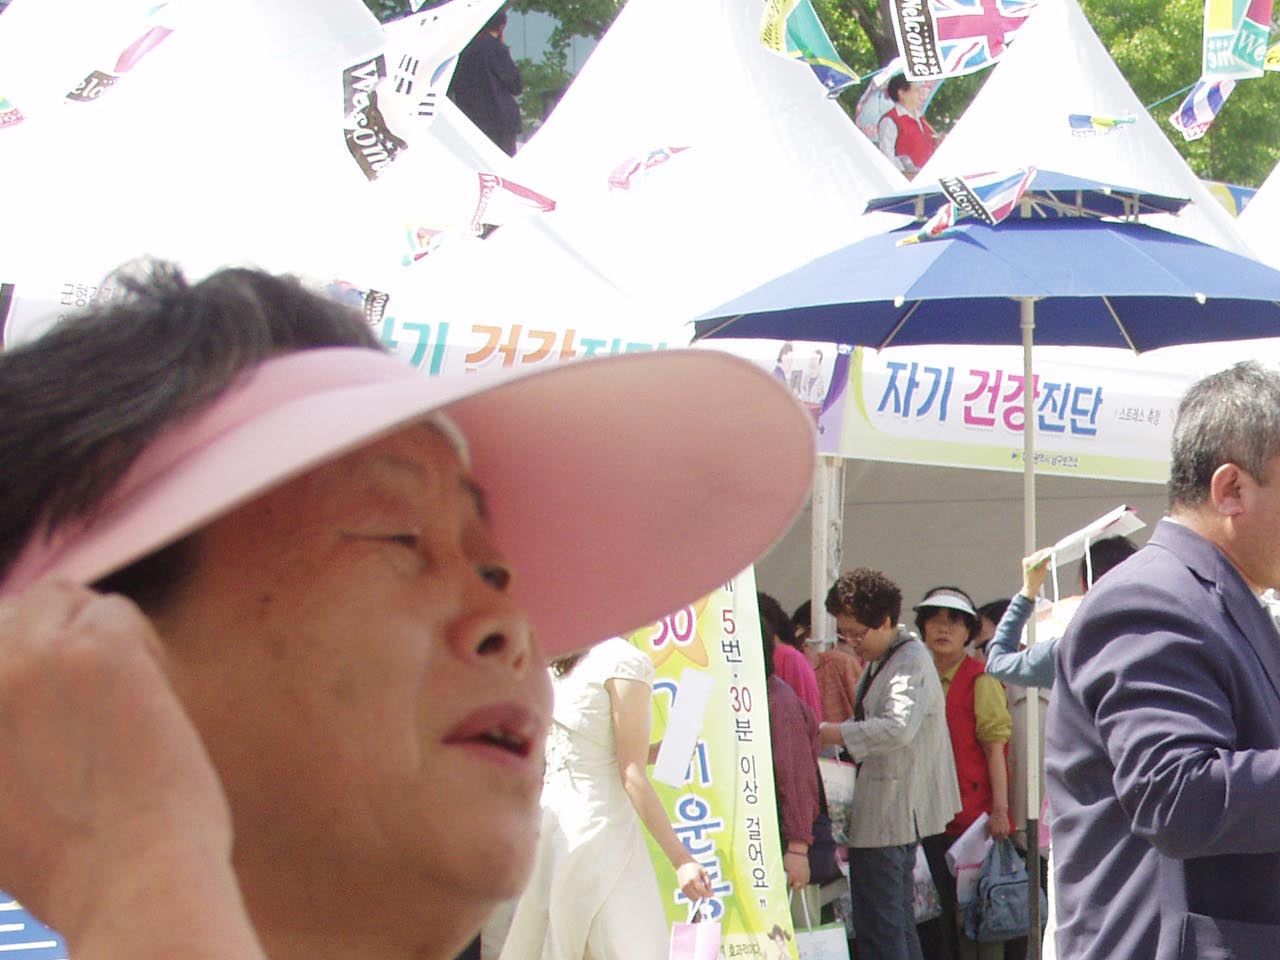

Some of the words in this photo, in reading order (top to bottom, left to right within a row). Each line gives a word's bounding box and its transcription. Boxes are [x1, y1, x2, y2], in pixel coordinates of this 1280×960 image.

[878, 362, 954, 421] 자기
[963, 369, 1104, 436] 건강진단
[740, 754, 759, 805] 이상
